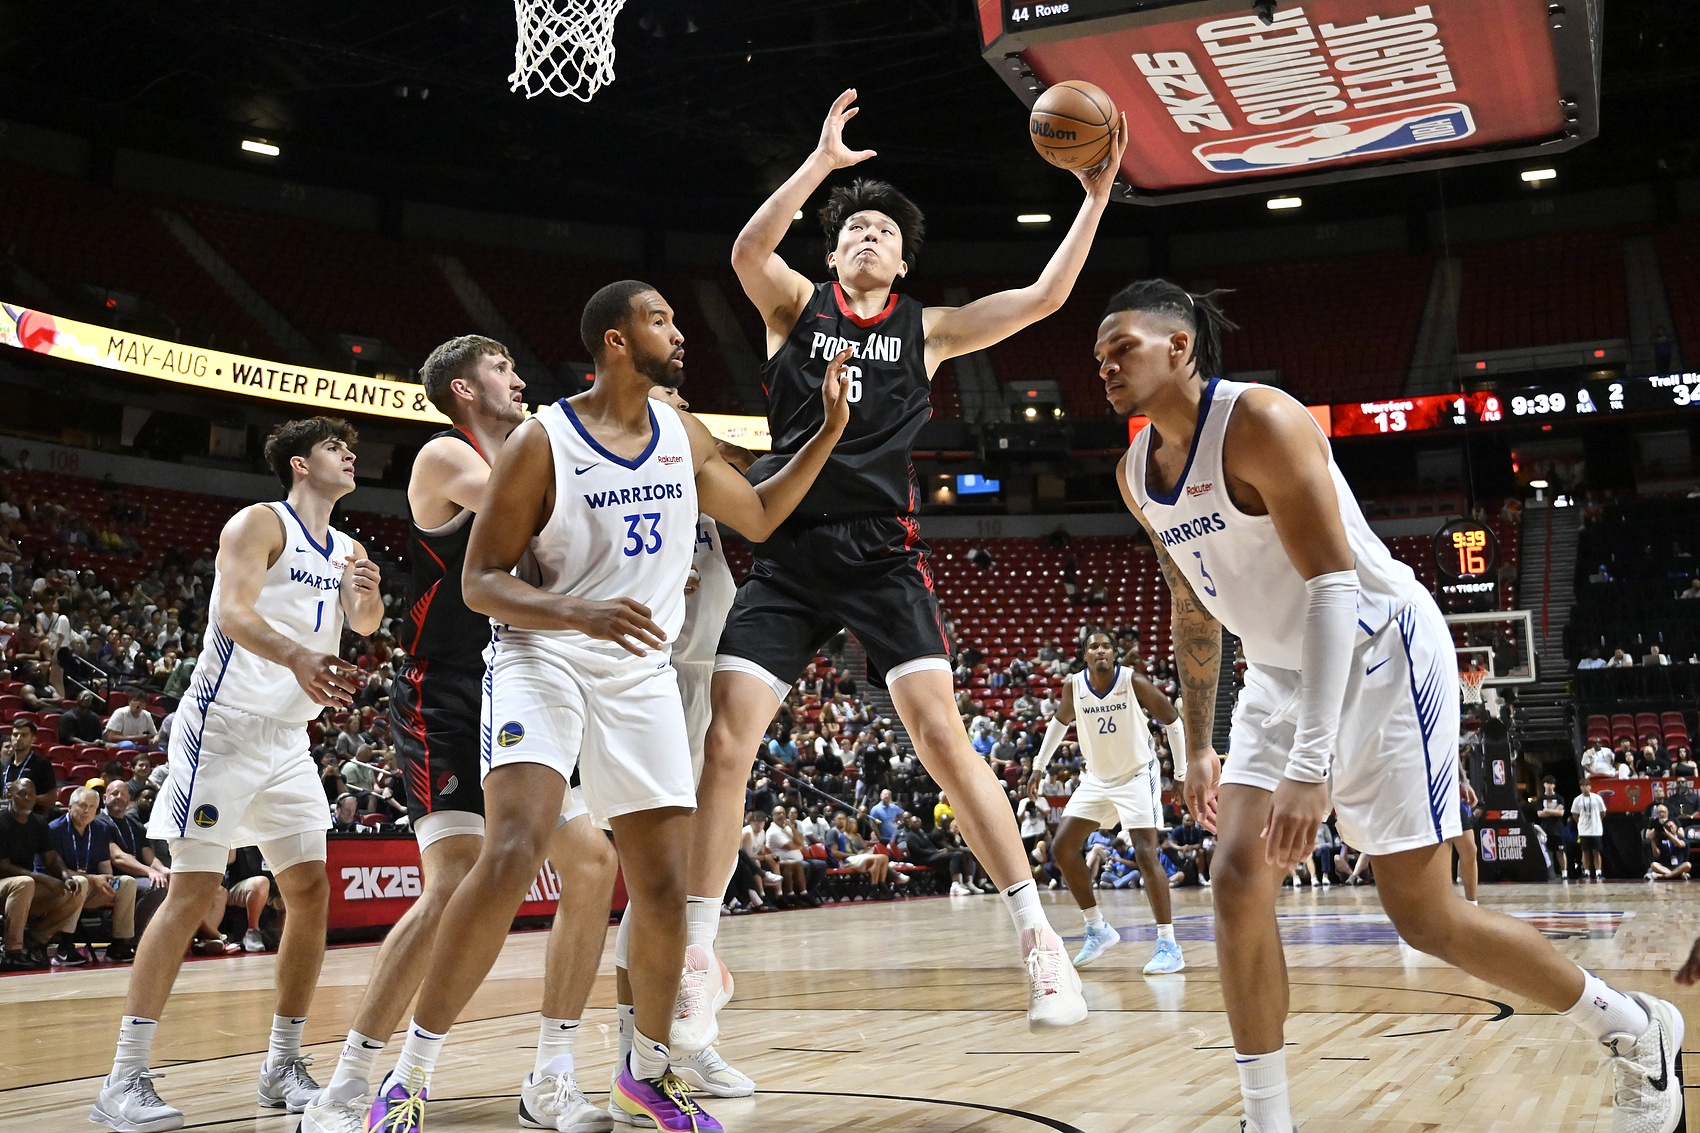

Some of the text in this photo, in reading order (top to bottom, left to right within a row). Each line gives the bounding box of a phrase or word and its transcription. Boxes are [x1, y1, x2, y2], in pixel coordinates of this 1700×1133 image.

[1011, 3, 1070, 22] 44 Rowe
[1196, 7, 1348, 125] SUMMER
[1318, 4, 1457, 109] LEAGUE
[1131, 52, 1233, 133] 2K26
[107, 336, 427, 412] MAY-AUG WATER PLANTS &
[1608, 383, 1624, 401] 2
[1360, 400, 1414, 414] Warriors
[1453, 397, 1466, 415] 1
[1486, 397, 1499, 411] 0
[1511, 392, 1566, 416] 9:39
[1374, 411, 1407, 432] 13
[1484, 411, 1501, 422] FLS
[50, 450, 79, 472] 108
[657, 455, 684, 465] Rakuten
[583, 483, 683, 509] WARRIORS
[623, 512, 663, 557] 33
[1159, 512, 1226, 547] ARRORS
[1452, 530, 1486, 548] 9:39
[1459, 546, 1485, 574] 16
[1456, 582, 1494, 593] TISSOT
[313, 600, 324, 632] 1
[1082, 702, 1127, 714] WARRIORS
[1097, 716, 1117, 734] 26
[1497, 835, 1527, 848] SUMMER
[1499, 847, 1524, 860] LEAGUE
[341, 866, 423, 900] 2K26
